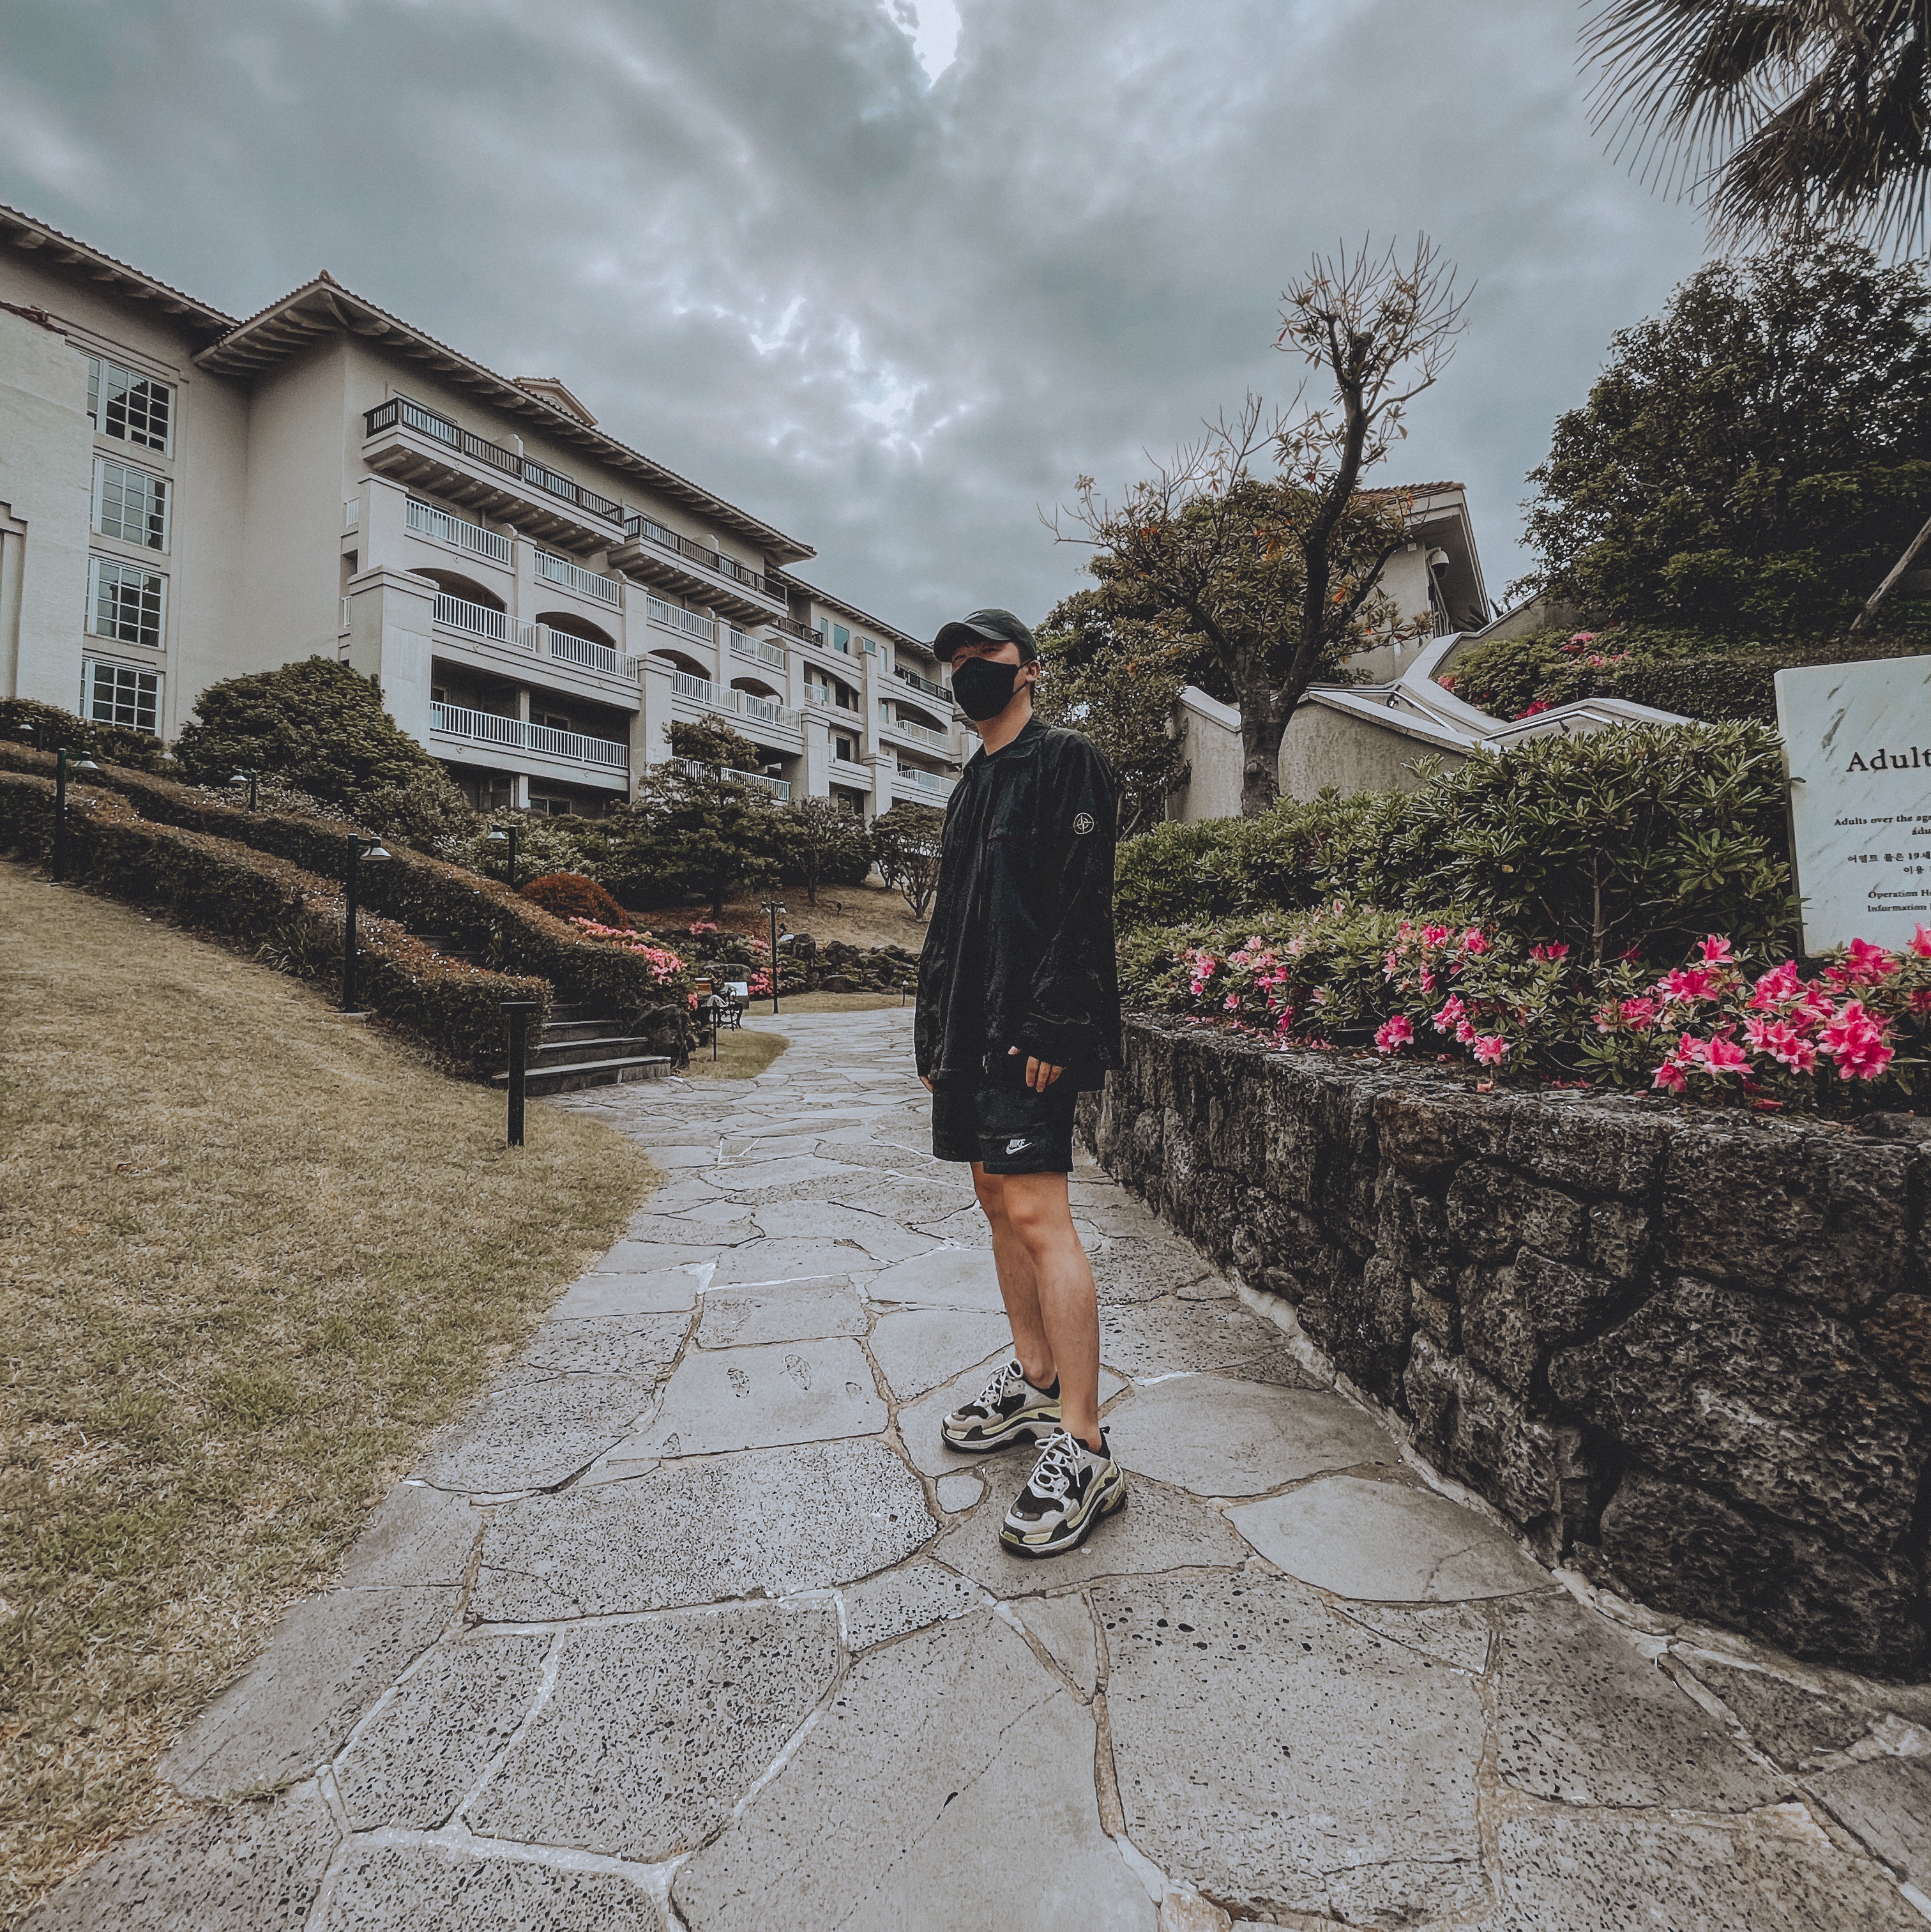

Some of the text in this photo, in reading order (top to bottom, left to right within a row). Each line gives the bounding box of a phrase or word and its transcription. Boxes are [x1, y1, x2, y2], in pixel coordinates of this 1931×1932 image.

[1845, 746, 1931, 772] Adult
[1834, 817, 1868, 826] Adults
[1896, 814, 1912, 823] the
[1868, 890, 1918, 899] Operation
[1867, 903, 1927, 912] Information
